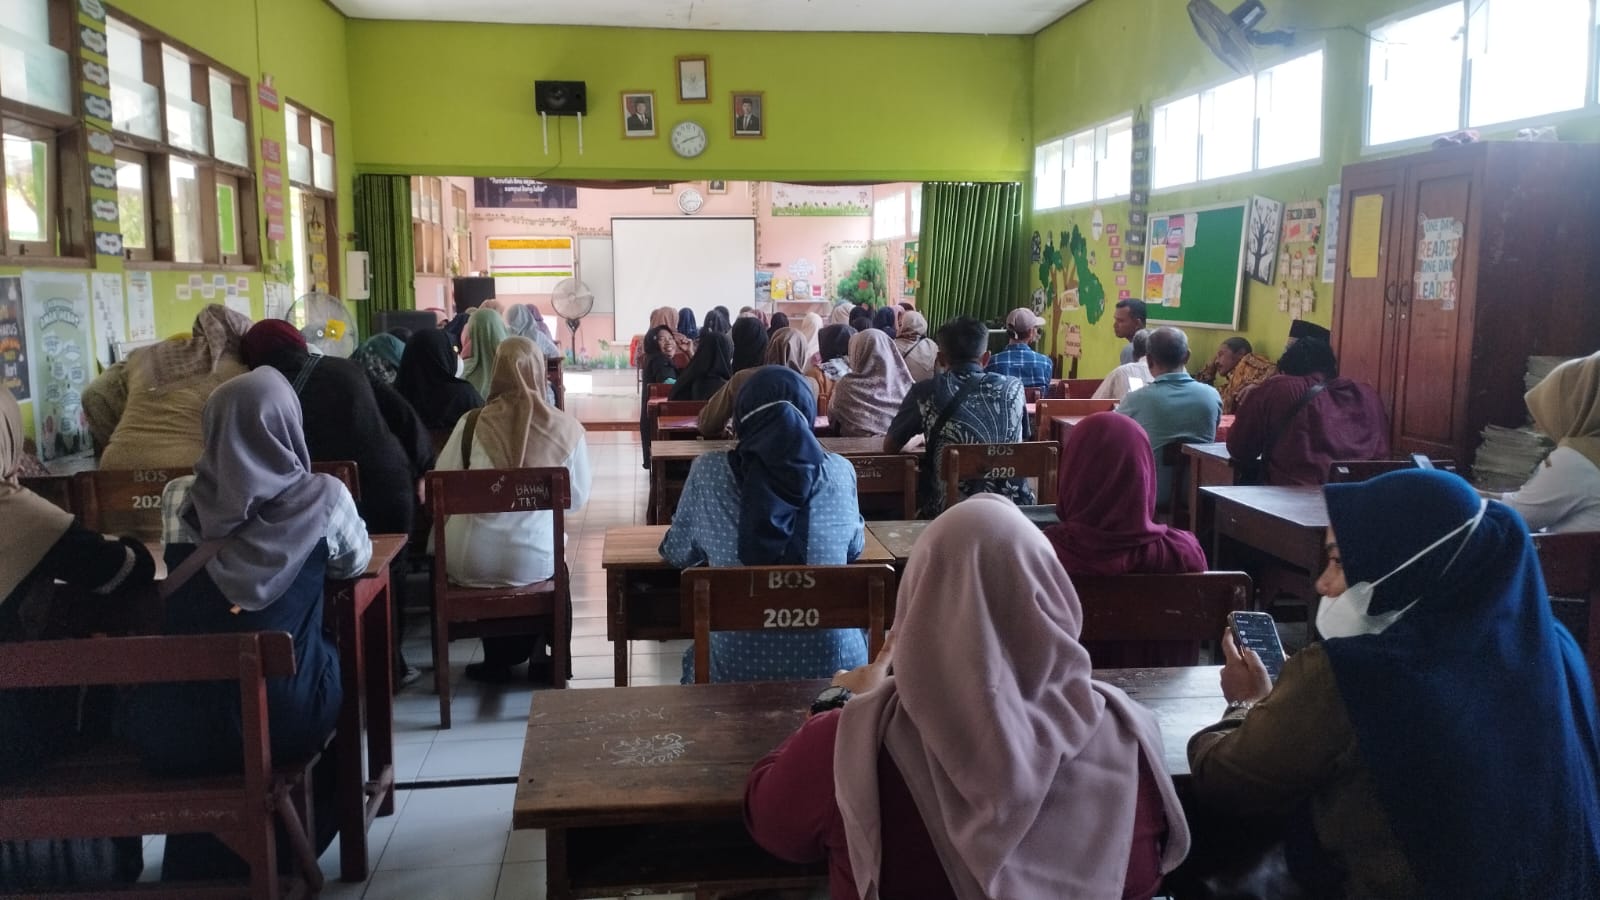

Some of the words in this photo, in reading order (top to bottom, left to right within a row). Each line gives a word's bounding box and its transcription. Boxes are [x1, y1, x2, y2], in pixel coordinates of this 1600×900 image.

[1420, 240, 1459, 257] READER
[1423, 261, 1437, 273] ONE
[1417, 281, 1456, 299] LEADER
[987, 445, 1015, 456] BOS
[134, 470, 168, 482] BOS
[131, 495, 161, 509] 202
[768, 570, 816, 589] BOS
[763, 608, 820, 628] 2020
